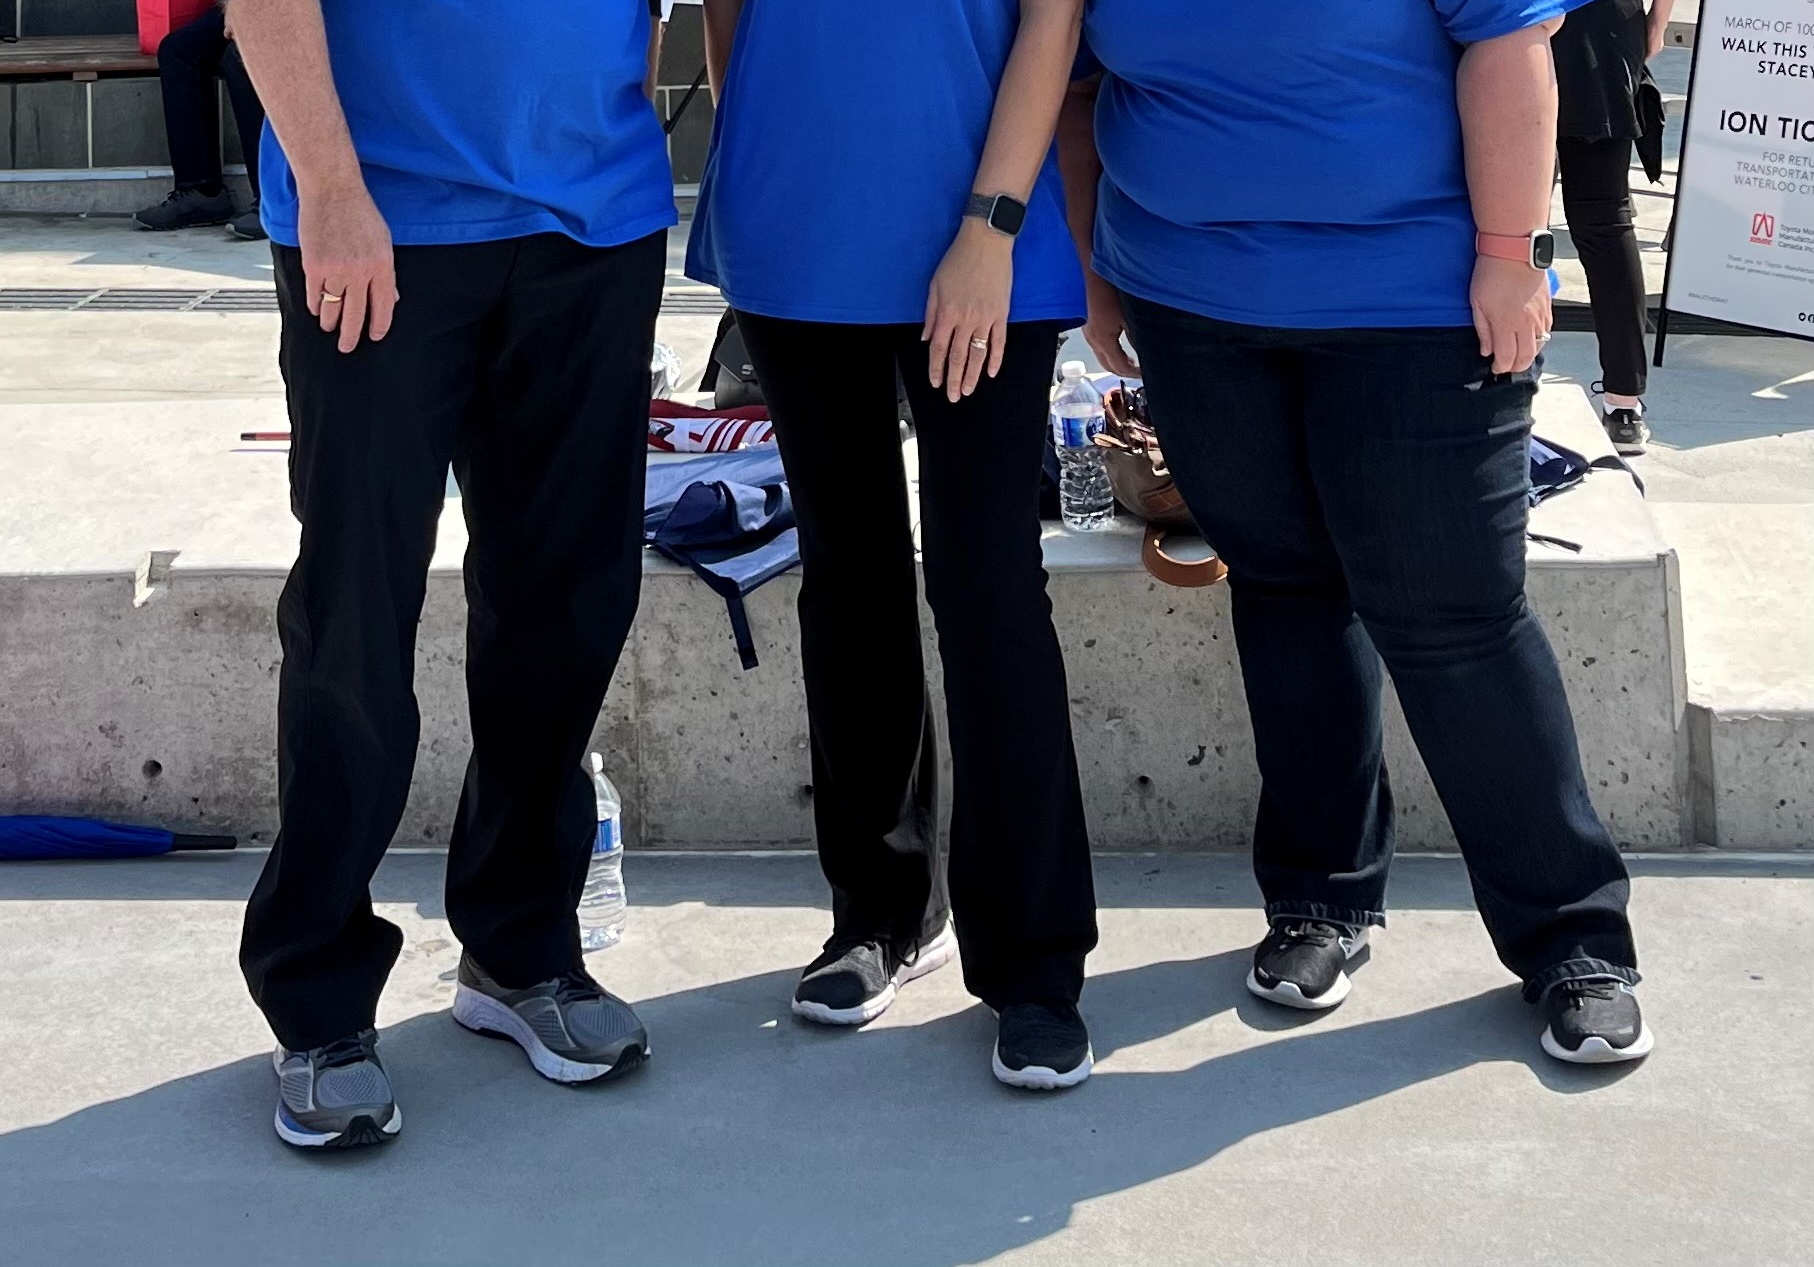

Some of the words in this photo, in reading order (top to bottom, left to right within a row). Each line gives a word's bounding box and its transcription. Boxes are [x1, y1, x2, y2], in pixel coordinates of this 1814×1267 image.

[1725, 16, 1771, 32] MARCH
[1774, 20, 1793, 33] OF
[1721, 36, 1767, 54] WALK
[1773, 41, 1808, 59] THIS
[1719, 109, 1768, 136] ION
[1762, 151, 1785, 164] FOR
[1734, 174, 1796, 193] WATERLOO
